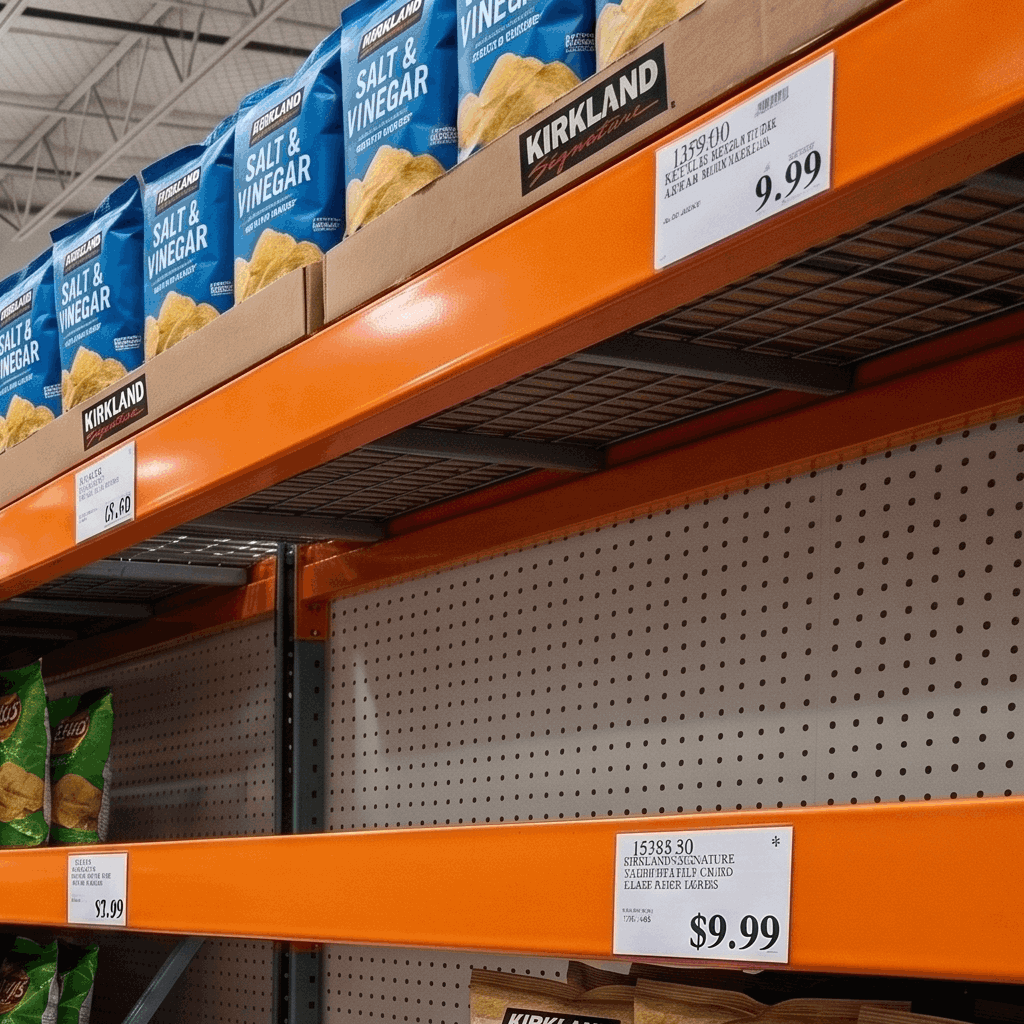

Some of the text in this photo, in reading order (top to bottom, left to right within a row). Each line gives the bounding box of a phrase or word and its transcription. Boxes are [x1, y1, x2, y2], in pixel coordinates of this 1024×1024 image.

[356, 36, 417, 99] SALT &
[347, 64, 428, 139] VINEGAR
[526, 59, 659, 165] KIRKLAND
[245, 127, 301, 183] SALT &
[755, 150, 822, 213] 9.99
[238, 154, 312, 219] VINEGAR
[147, 224, 209, 280] VINEGAR
[152, 200, 200, 248] SALT &
[59, 286, 111, 333] VINEGAR
[61, 262, 103, 306] SALT &
[84, 380, 145, 432] KIRKLAND
[690, 912, 780, 951] $9.99
